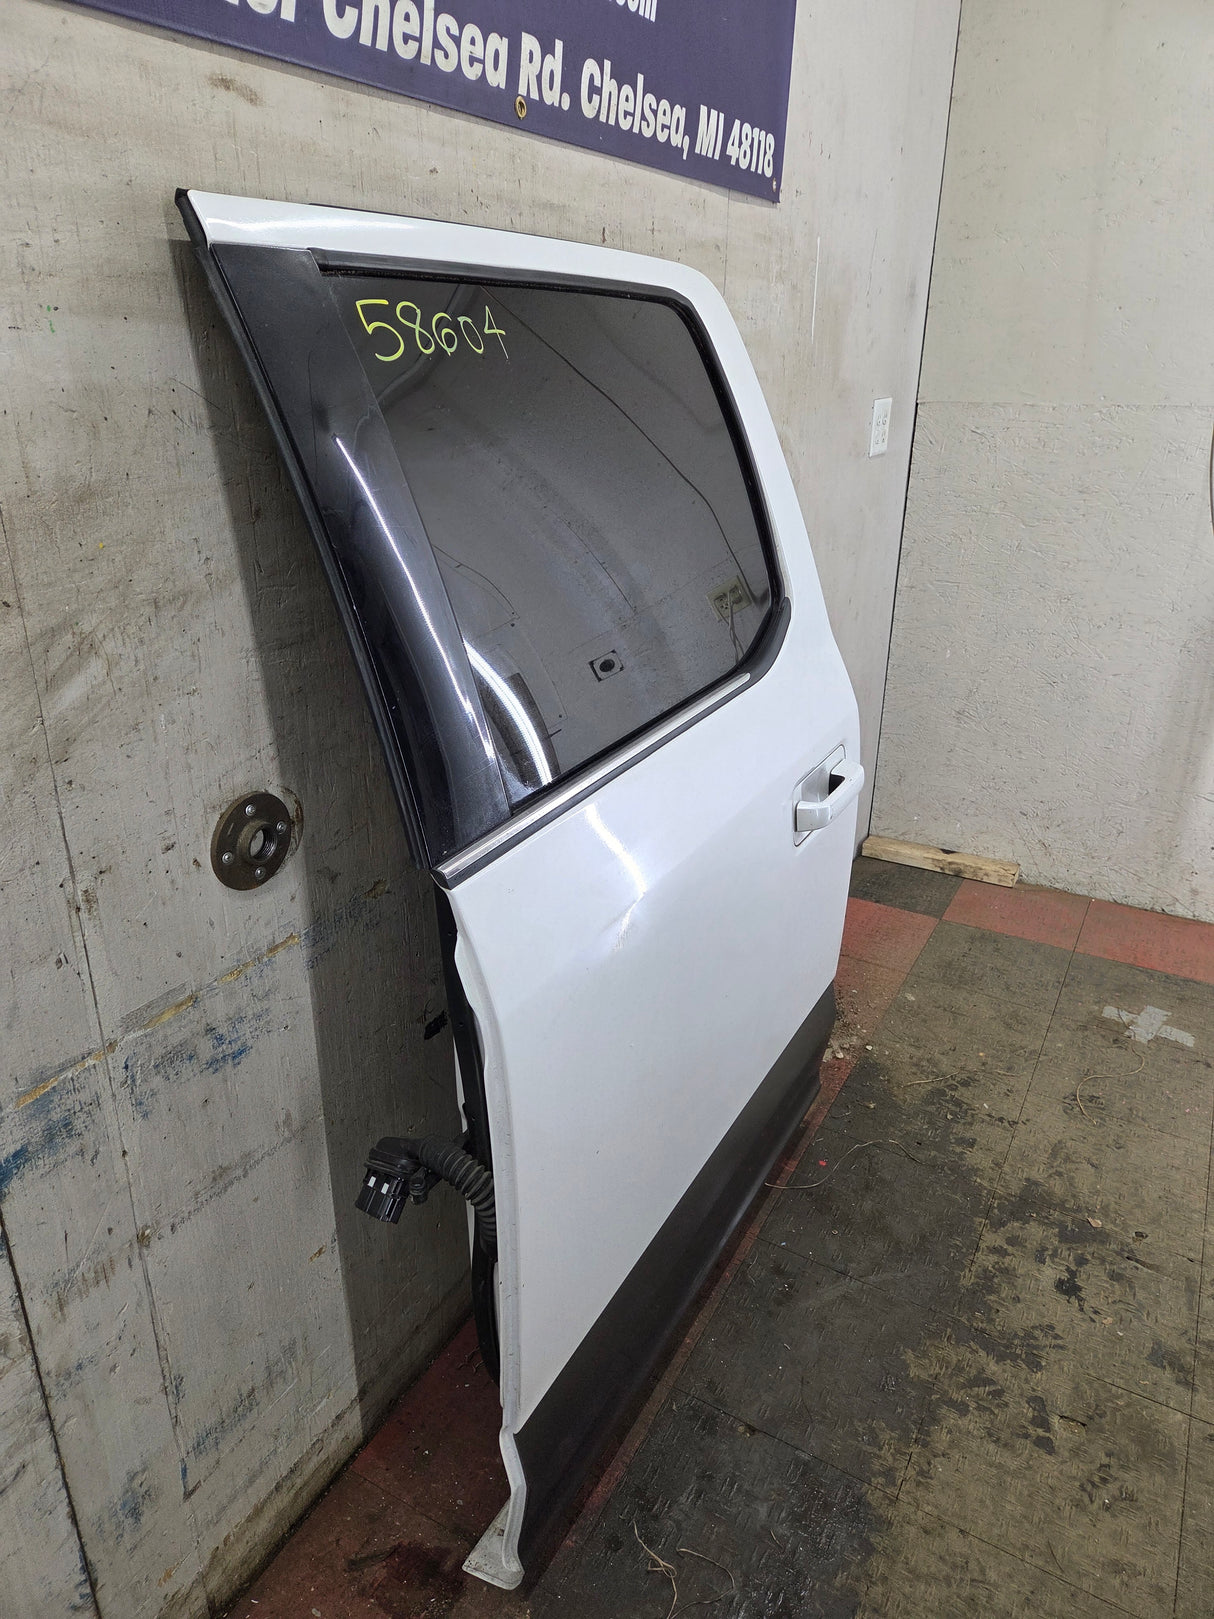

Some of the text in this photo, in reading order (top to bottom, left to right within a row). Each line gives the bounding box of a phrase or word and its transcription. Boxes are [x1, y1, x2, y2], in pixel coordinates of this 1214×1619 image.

[517, 31, 571, 111] Rd.
[580, 58, 690, 161] Chelsea,
[695, 104, 725, 161] MI
[726, 119, 775, 178] 48118
[355, 299, 509, 362] 58604
